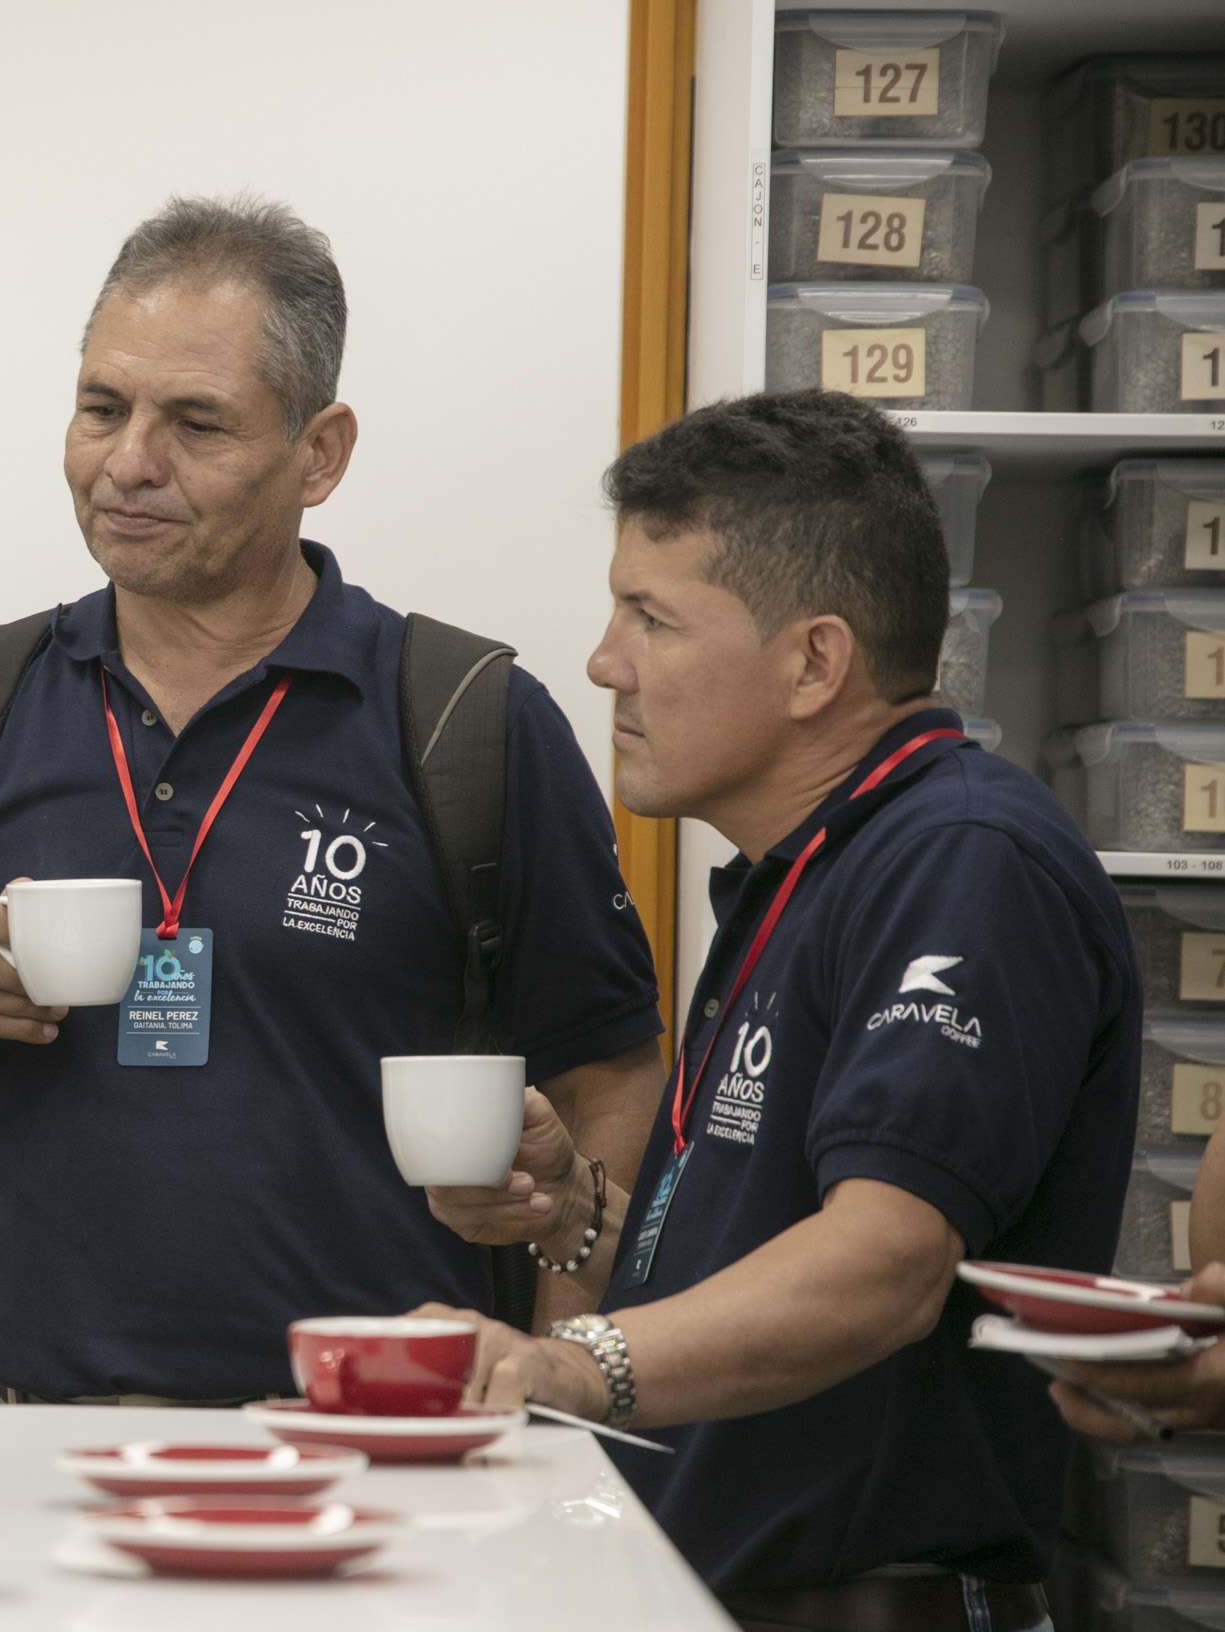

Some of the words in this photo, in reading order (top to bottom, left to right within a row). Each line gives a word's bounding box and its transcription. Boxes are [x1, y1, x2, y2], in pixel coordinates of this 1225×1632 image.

[855, 63, 928, 103] 127
[753, 165, 763, 227] CAJON
[836, 210, 907, 252] 128
[753, 264, 760, 274] E
[842, 343, 914, 384] 129
[897, 416, 918, 427] 126
[300, 829, 366, 880] 10
[1167, 860, 1188, 870] 103
[1201, 861, 1223, 870] 108
[290, 873, 362, 904] AÑOS
[287, 897, 359, 921] TRABAJANDO
[282, 916, 295, 928] LA
[297, 920, 355, 941] EXCELENCIA
[336, 918, 358, 931] POR
[142, 954, 181, 982] 10
[134, 989, 145, 1002] la
[147, 989, 197, 1002] excelencia
[138, 981, 195, 989] TRABAJANDO
[129, 1010, 164, 1020] REINEL
[166, 1011, 199, 1021] PEREZ
[168, 1022, 193, 1030] TOLIMA
[867, 1002, 982, 1038] CARAVELA
[730, 1021, 772, 1077] 10
[717, 1072, 765, 1103] AÑOS
[711, 1101, 762, 1122] TRABAJANDO
[740, 1119, 759, 1133] POR
